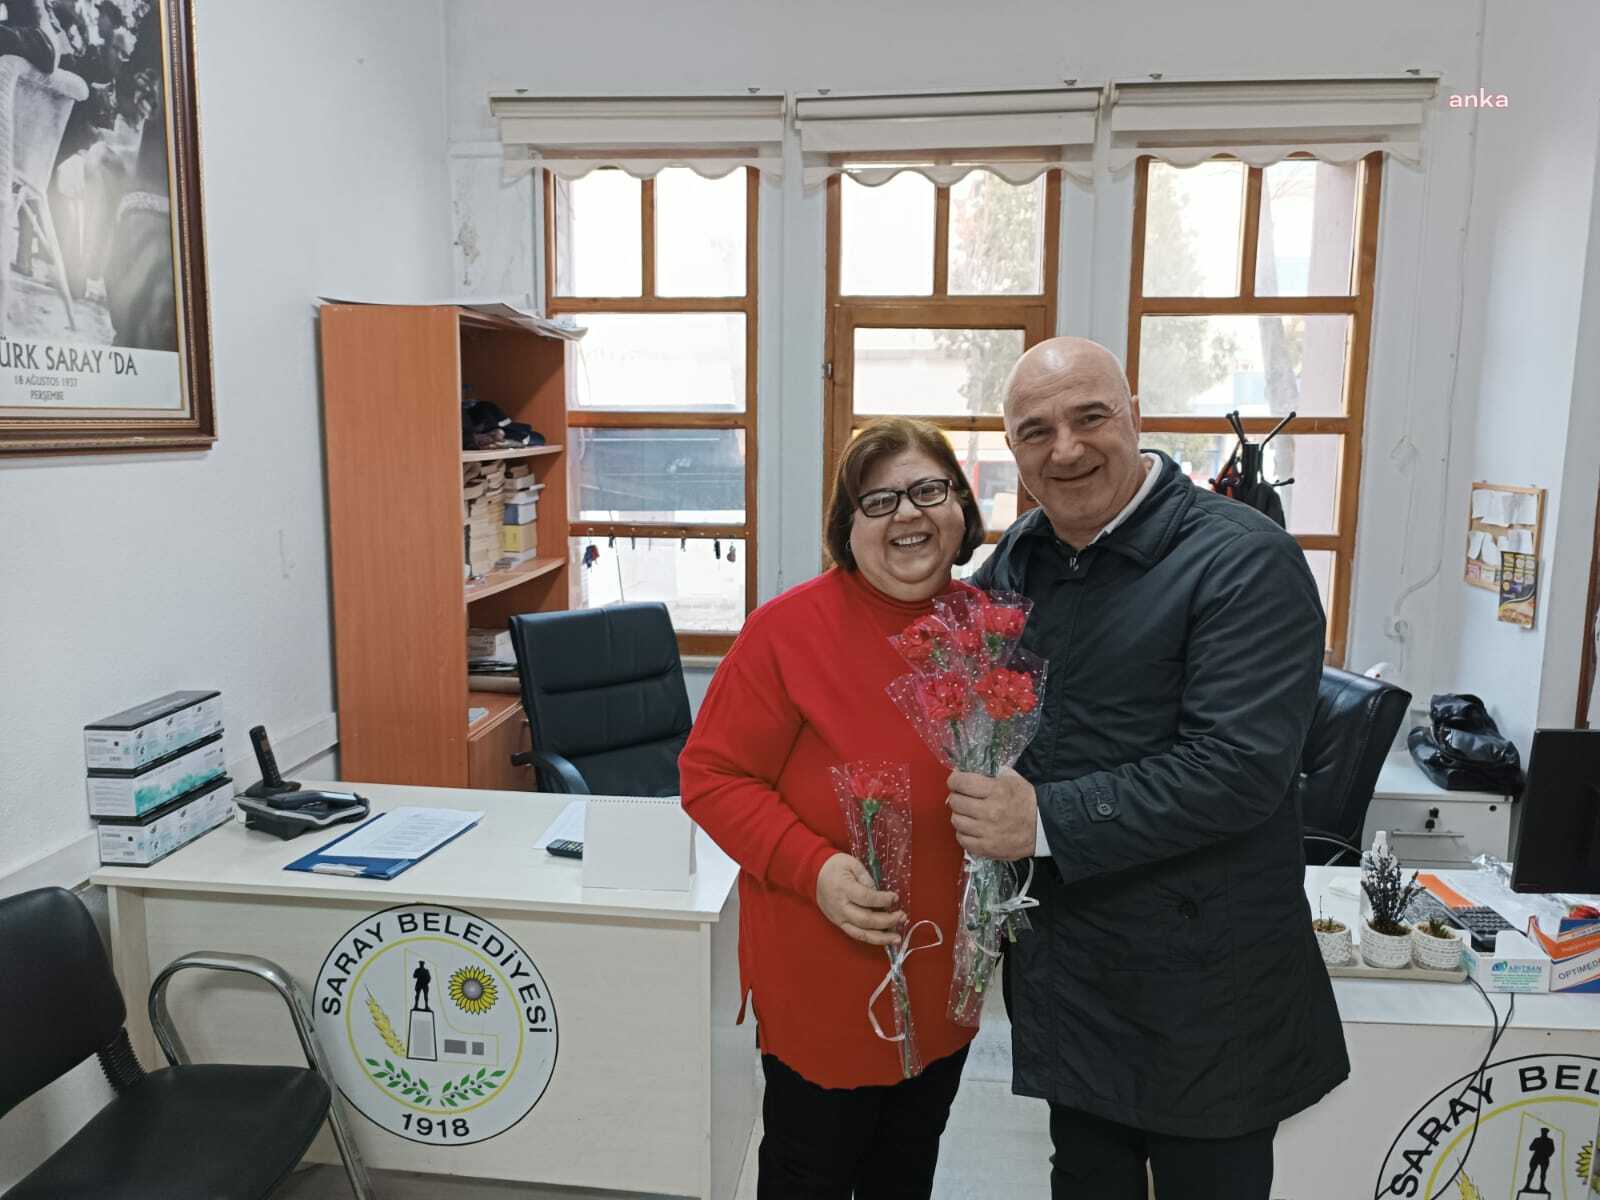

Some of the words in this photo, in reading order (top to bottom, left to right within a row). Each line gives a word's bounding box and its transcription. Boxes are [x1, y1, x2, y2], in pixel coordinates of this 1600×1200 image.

[45, 346, 103, 373] SARAY
[14, 375, 23, 385] 18
[322, 922, 385, 1016] SARAY
[397, 912, 552, 1033] BELEDİYESİ
[402, 1113, 470, 1138] 1918
[1390, 1077, 1494, 1198] SARAY
